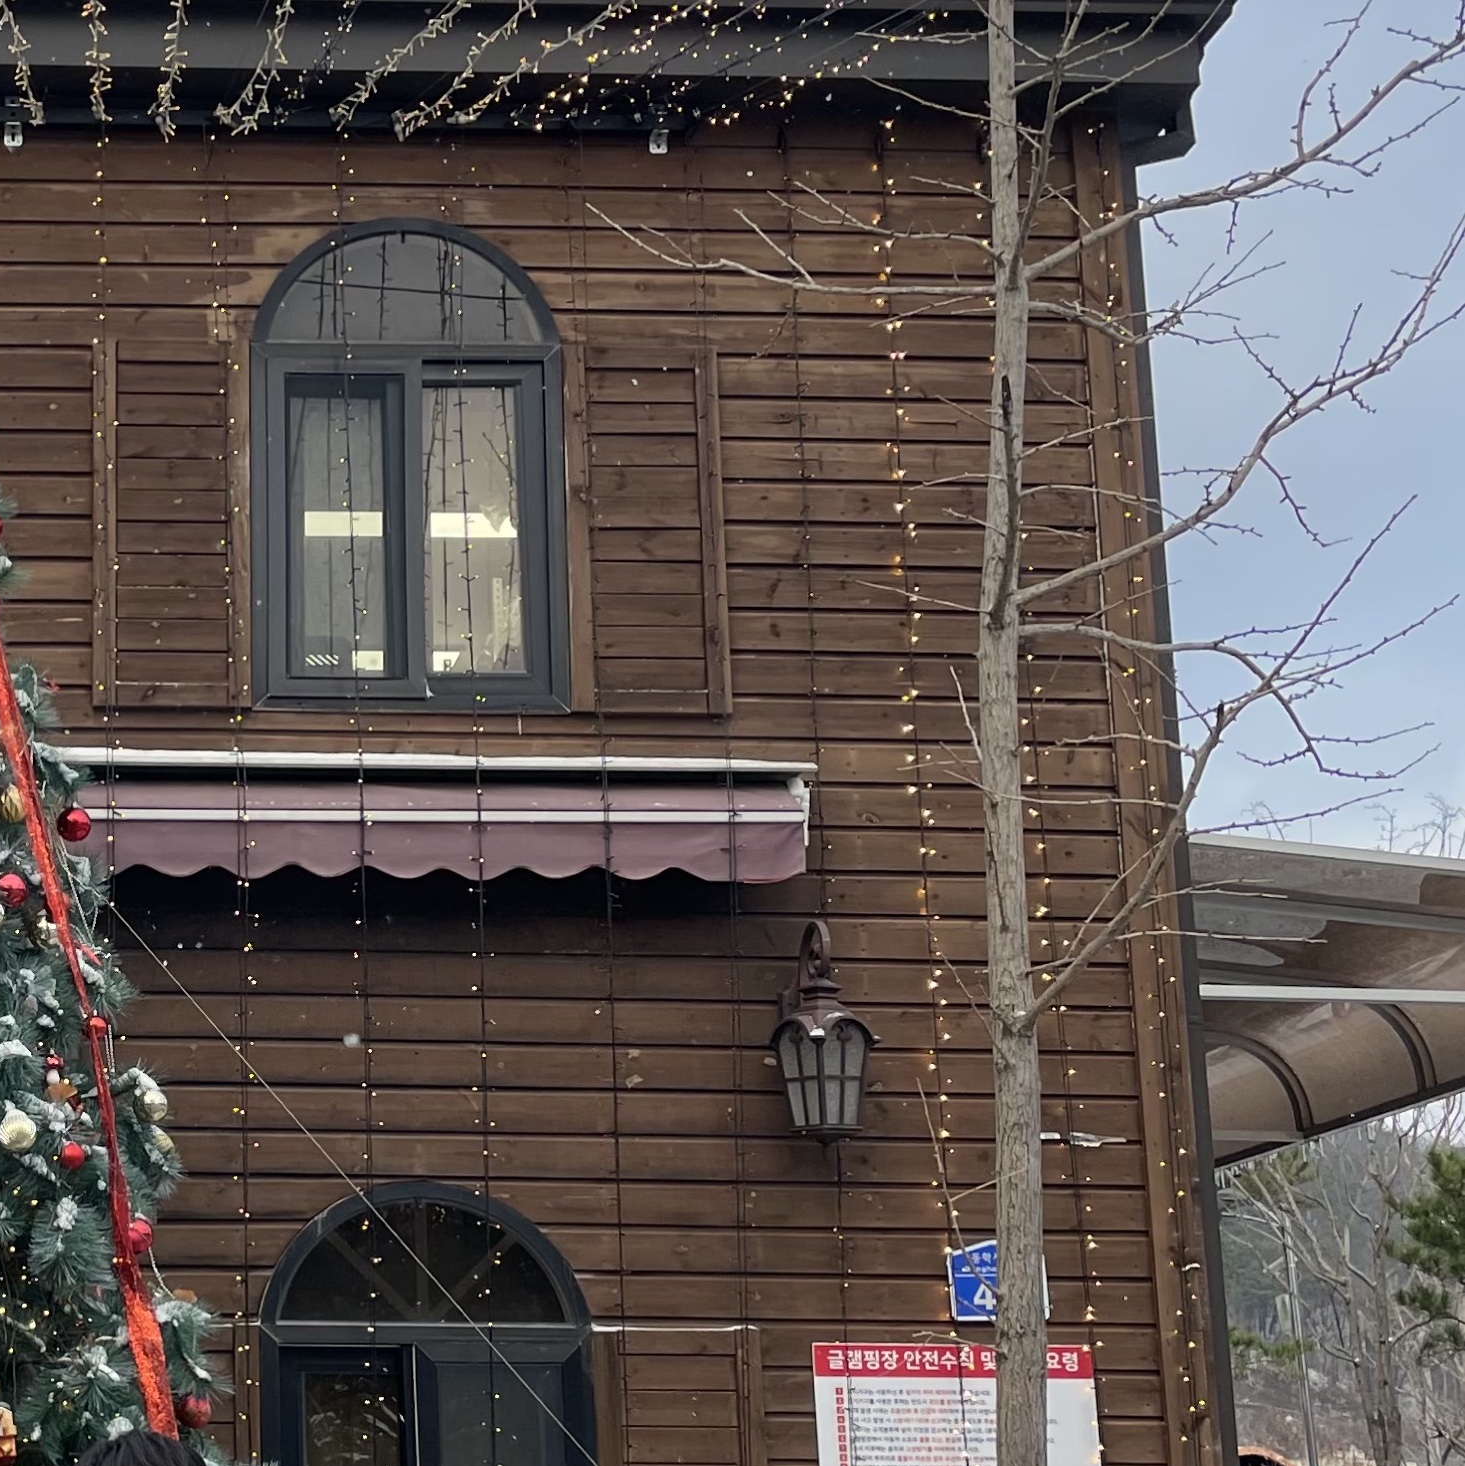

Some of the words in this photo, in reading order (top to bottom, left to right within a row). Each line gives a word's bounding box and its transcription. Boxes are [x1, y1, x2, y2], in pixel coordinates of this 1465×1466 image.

[971, 1252, 997, 1265] 동학
[827, 1349, 899, 1371] 글램핑장
[903, 1350, 975, 1371] 안전수칙
